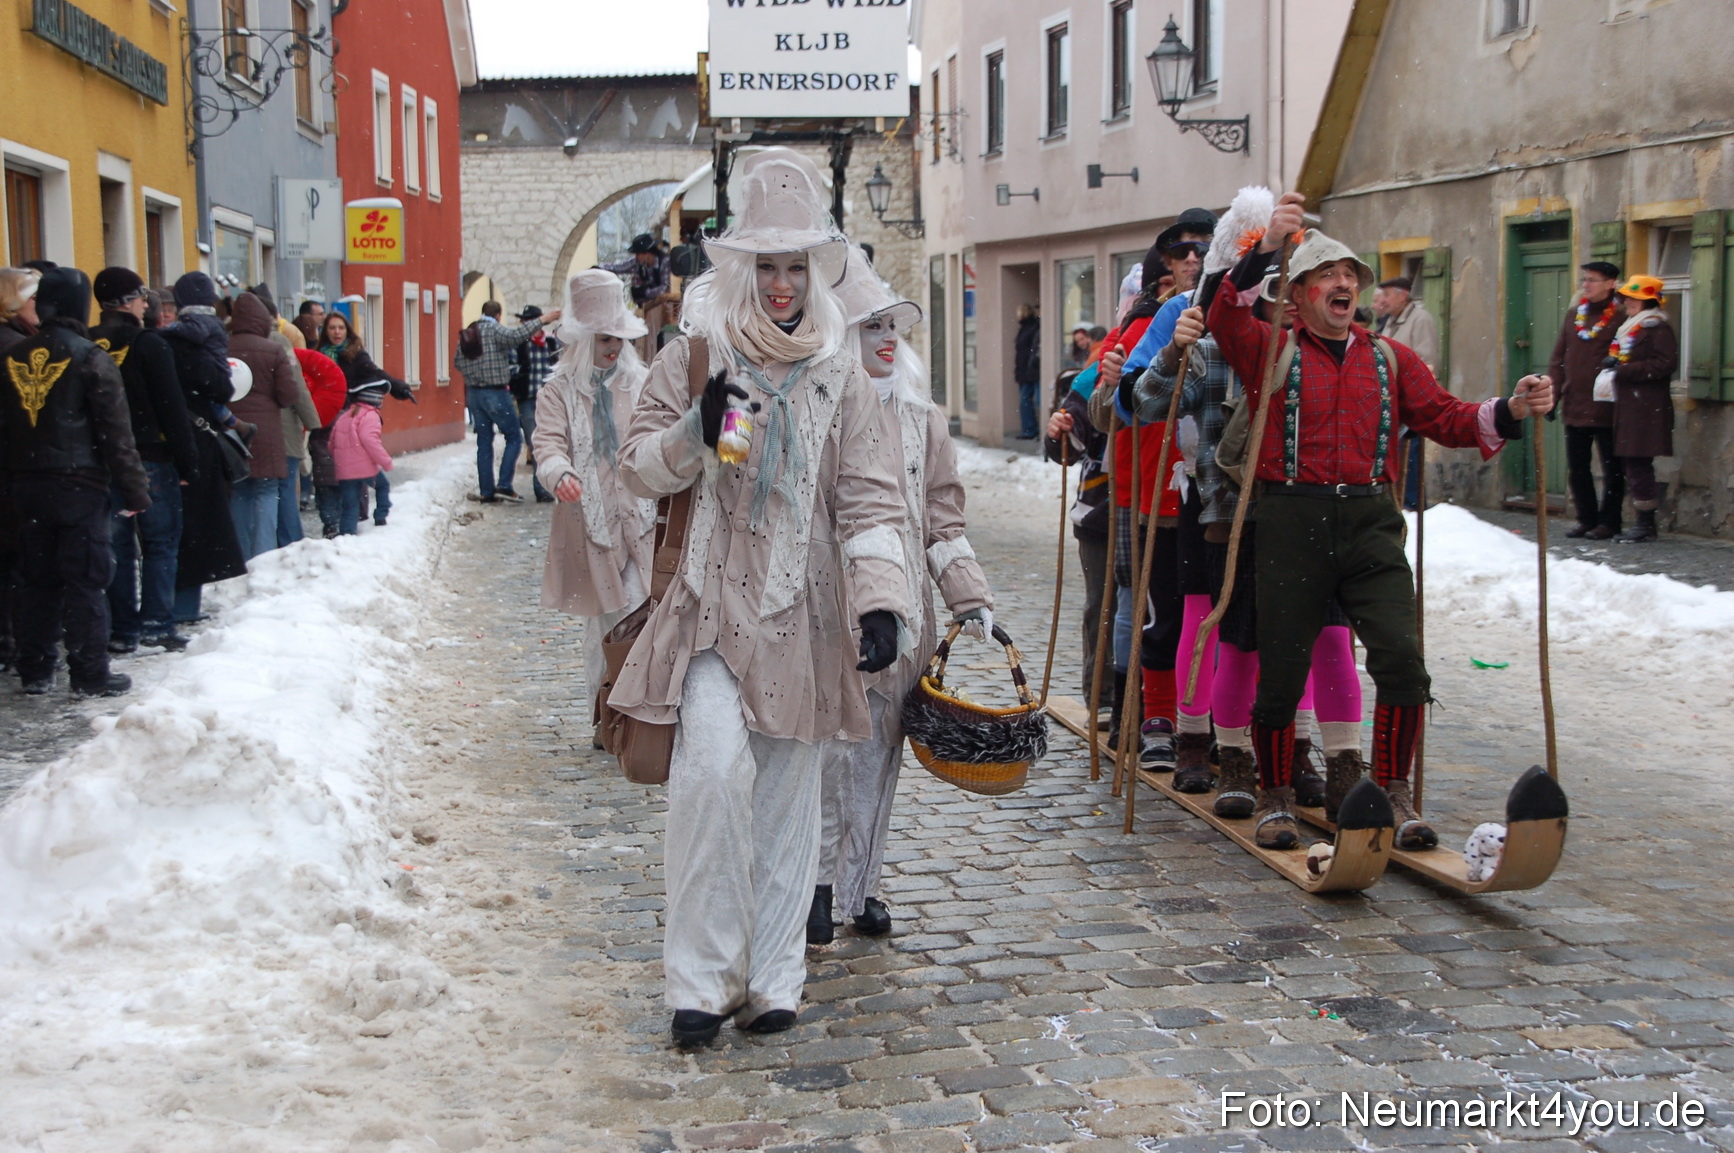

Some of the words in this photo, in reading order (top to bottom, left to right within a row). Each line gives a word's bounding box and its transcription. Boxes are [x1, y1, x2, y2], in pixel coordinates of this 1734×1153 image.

[775, 32, 850, 51] KLJB
[719, 72, 899, 91] ERNERSDORF
[353, 237, 396, 249] LOTTO
[362, 252, 387, 260] Bayern
